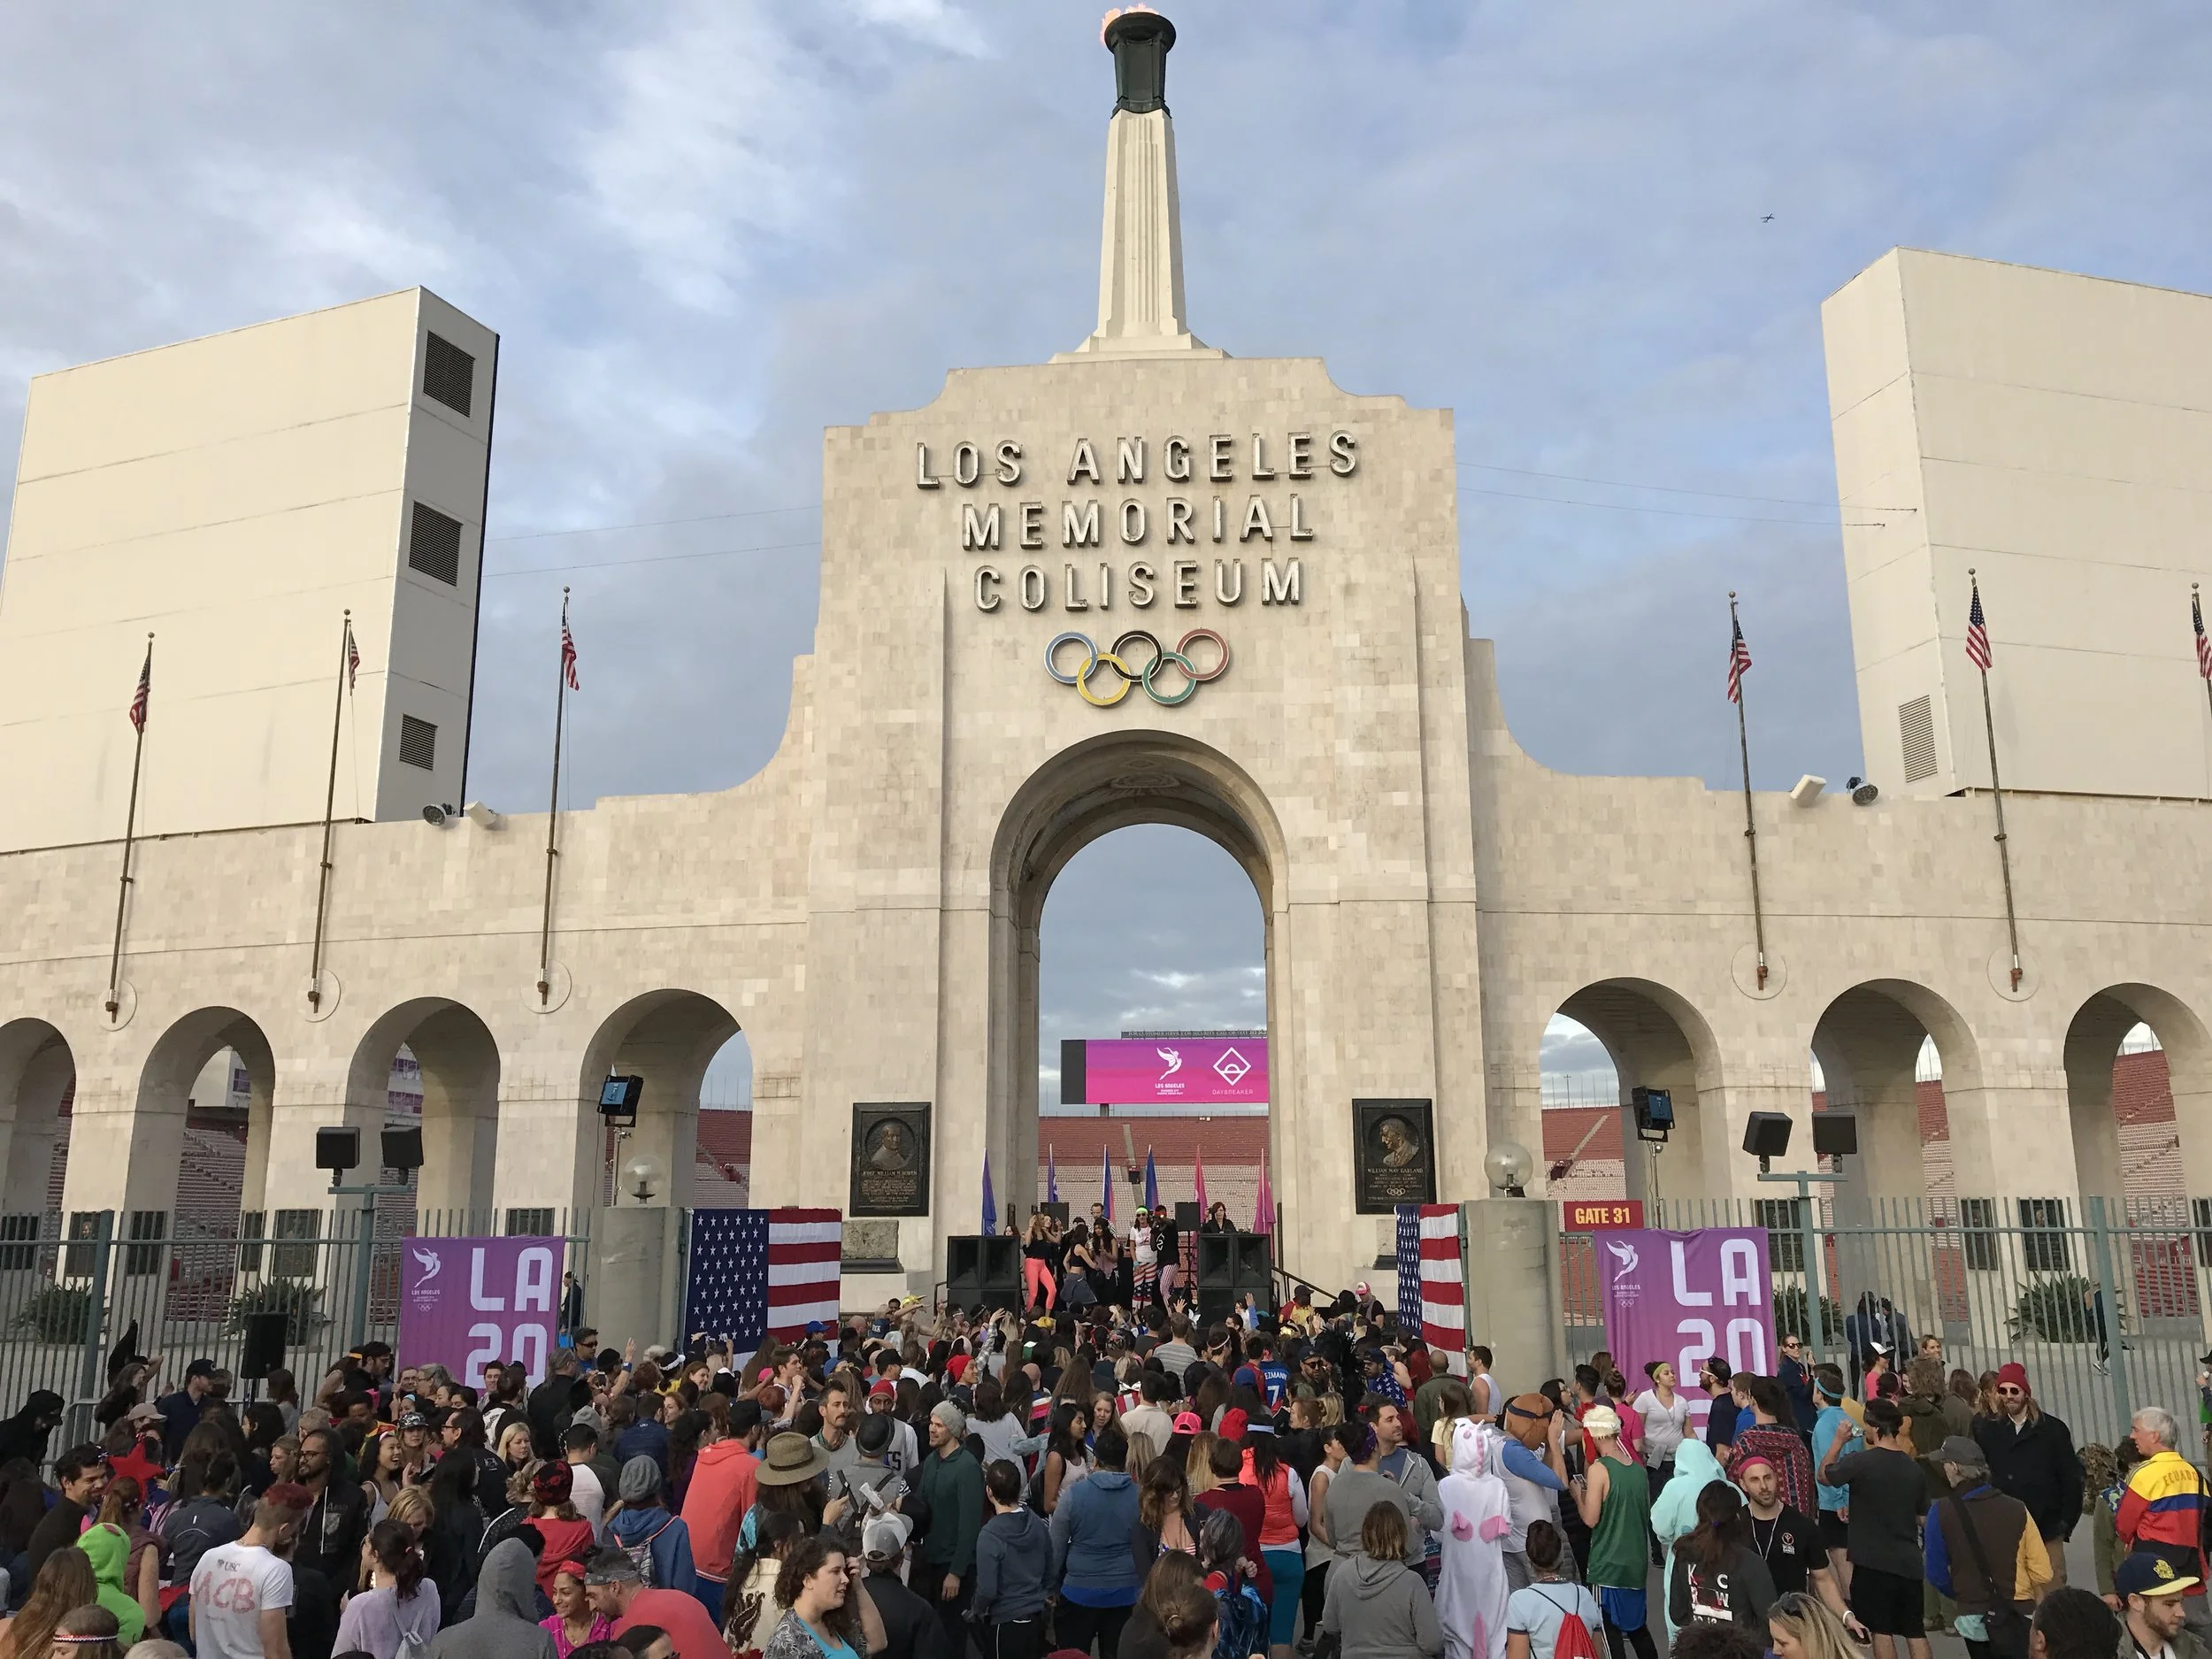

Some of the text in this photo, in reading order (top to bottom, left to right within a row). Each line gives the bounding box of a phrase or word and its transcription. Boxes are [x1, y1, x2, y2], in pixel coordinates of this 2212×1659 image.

[917, 430, 1359, 488] LOS ANGELES
[962, 494, 1314, 550] MEMORIAL
[973, 557, 1301, 612] COLISEUM
[1575, 1207, 1631, 1225] GATE 31
[470, 1247, 553, 1311] LA
[1670, 1239, 1762, 1306] LA
[465, 1323, 548, 1389] 20
[1677, 1317, 1768, 1387] 20
[1267, 1385, 1280, 1407] 7
[224, 1562, 241, 1572] USC
